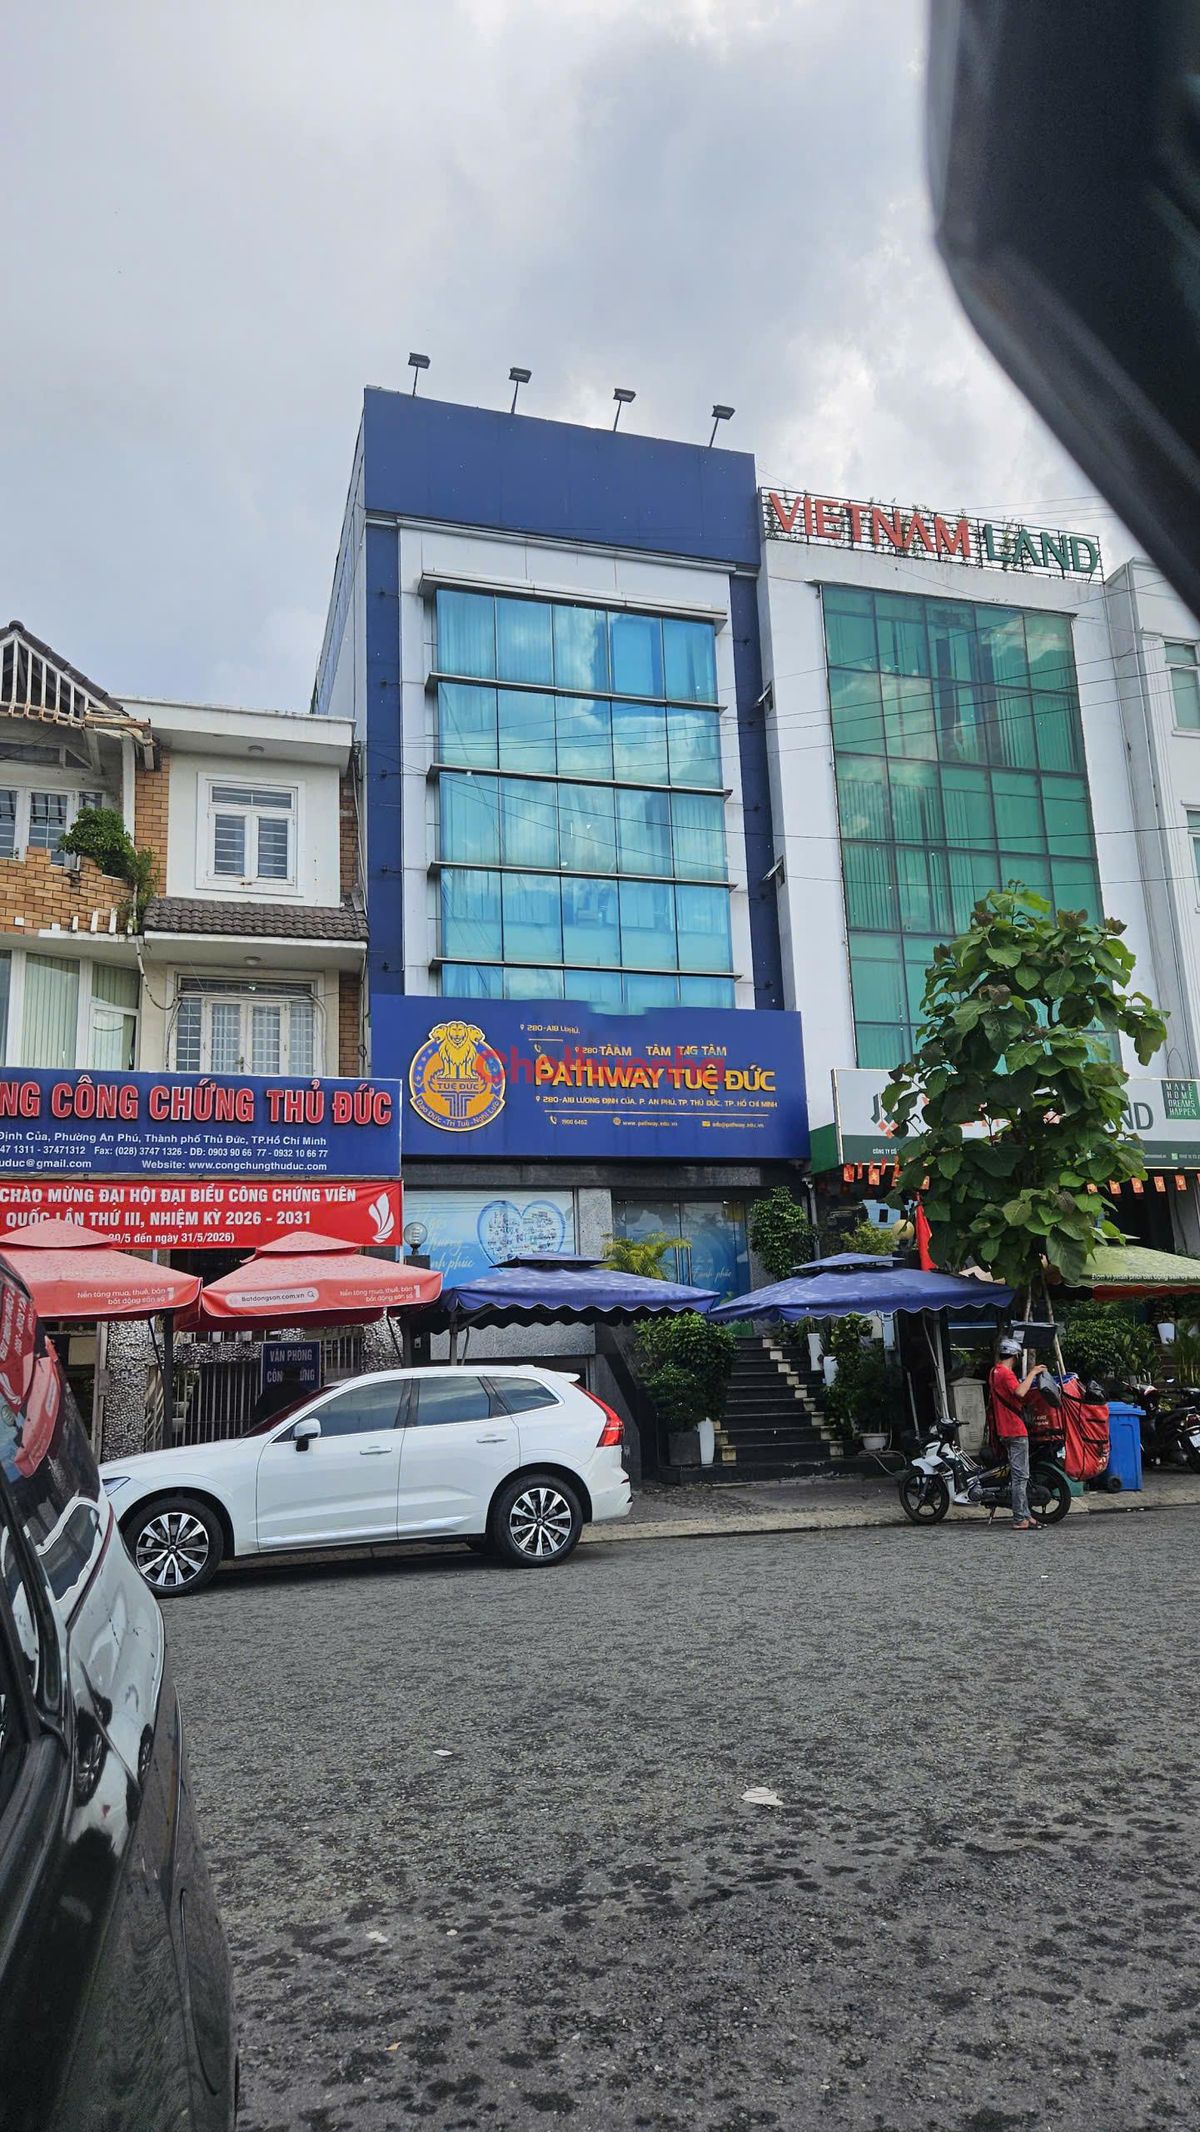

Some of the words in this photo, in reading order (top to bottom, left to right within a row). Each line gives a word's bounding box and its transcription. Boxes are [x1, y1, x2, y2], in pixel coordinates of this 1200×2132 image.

[769, 491, 971, 558] VIETNAM
[984, 523, 1098, 573] LAND
[646, 1044, 671, 1056] TÂM
[701, 1044, 727, 1056] TÂM
[535, 1058, 664, 1090] PATHWAY
[668, 1063, 719, 1095] TUỆ
[724, 1064, 776, 1091] ĐỨC
[1166, 1082, 1193, 1091] MAKE
[52, 1075, 139, 1120] CÔNG
[150, 1078, 254, 1122] CHỨNG
[266, 1079, 324, 1124] THỦ
[332, 1084, 392, 1125] ĐỨC
[1167, 1091, 1194, 1100] HOME
[1168, 1099, 1196, 1108] DREAMS
[1169, 1107, 1197, 1117] HAPPEN
[26, 1131, 51, 1142] Của,
[54, 1132, 96, 1144] Phường
[100, 1134, 114, 1142] An
[117, 1133, 141, 1144] Phú,
[145, 1133, 178, 1144] Thành
[180, 1133, 200, 1146] phố
[203, 1134, 223, 1144] Thủ
[226, 1135, 249, 1146] Đức,
[283, 1136, 300, 1145] Chí
[302, 1136, 327, 1146] Minh
[14, 1145, 34, 1154] 1311
[43, 1145, 86, 1155] 37471312
[94, 1147, 113, 1156] Fax:
[115, 1146, 137, 1157] (028)
[139, 1147, 159, 1156] 3747
[162, 1147, 182, 1156] 1326
[208, 1148, 228, 1157] 0903
[230, 1148, 240, 1157] 90
[242, 1148, 252, 1157] 66
[257, 1148, 267, 1157] 77
[273, 1149, 293, 1158] 0932
[295, 1149, 305, 1158] 10
[306, 1149, 316, 1158] 66
[318, 1149, 328, 1158] 77
[142, 1160, 186, 1170] Website:
[189, 1160, 327, 1172] www.congchungthuduc.com
[0, 1186, 43, 1203] CHÀO
[47, 1186, 94, 1203] MỪNG
[99, 1188, 125, 1206] ĐẠI
[130, 1186, 156, 1205] HỘI
[160, 1188, 186, 1206] ĐẠI
[190, 1184, 223, 1203] BIỂU
[228, 1186, 269, 1203] CÔNG
[272, 1185, 321, 1203] CHỨNG
[324, 1186, 357, 1202] VIÊN
[89, 1209, 121, 1226] THỨ
[125, 1211, 145, 1228] III,
[150, 1208, 199, 1229] NHIỆM
[203, 1209, 222, 1225] KỲ
[225, 1211, 262, 1226] 2026
[276, 1211, 311, 1225] 2031
[134, 1232, 152, 1243] đến
[155, 1233, 179, 1245] ngày
[181, 1232, 235, 1243] 31/5/2026)
